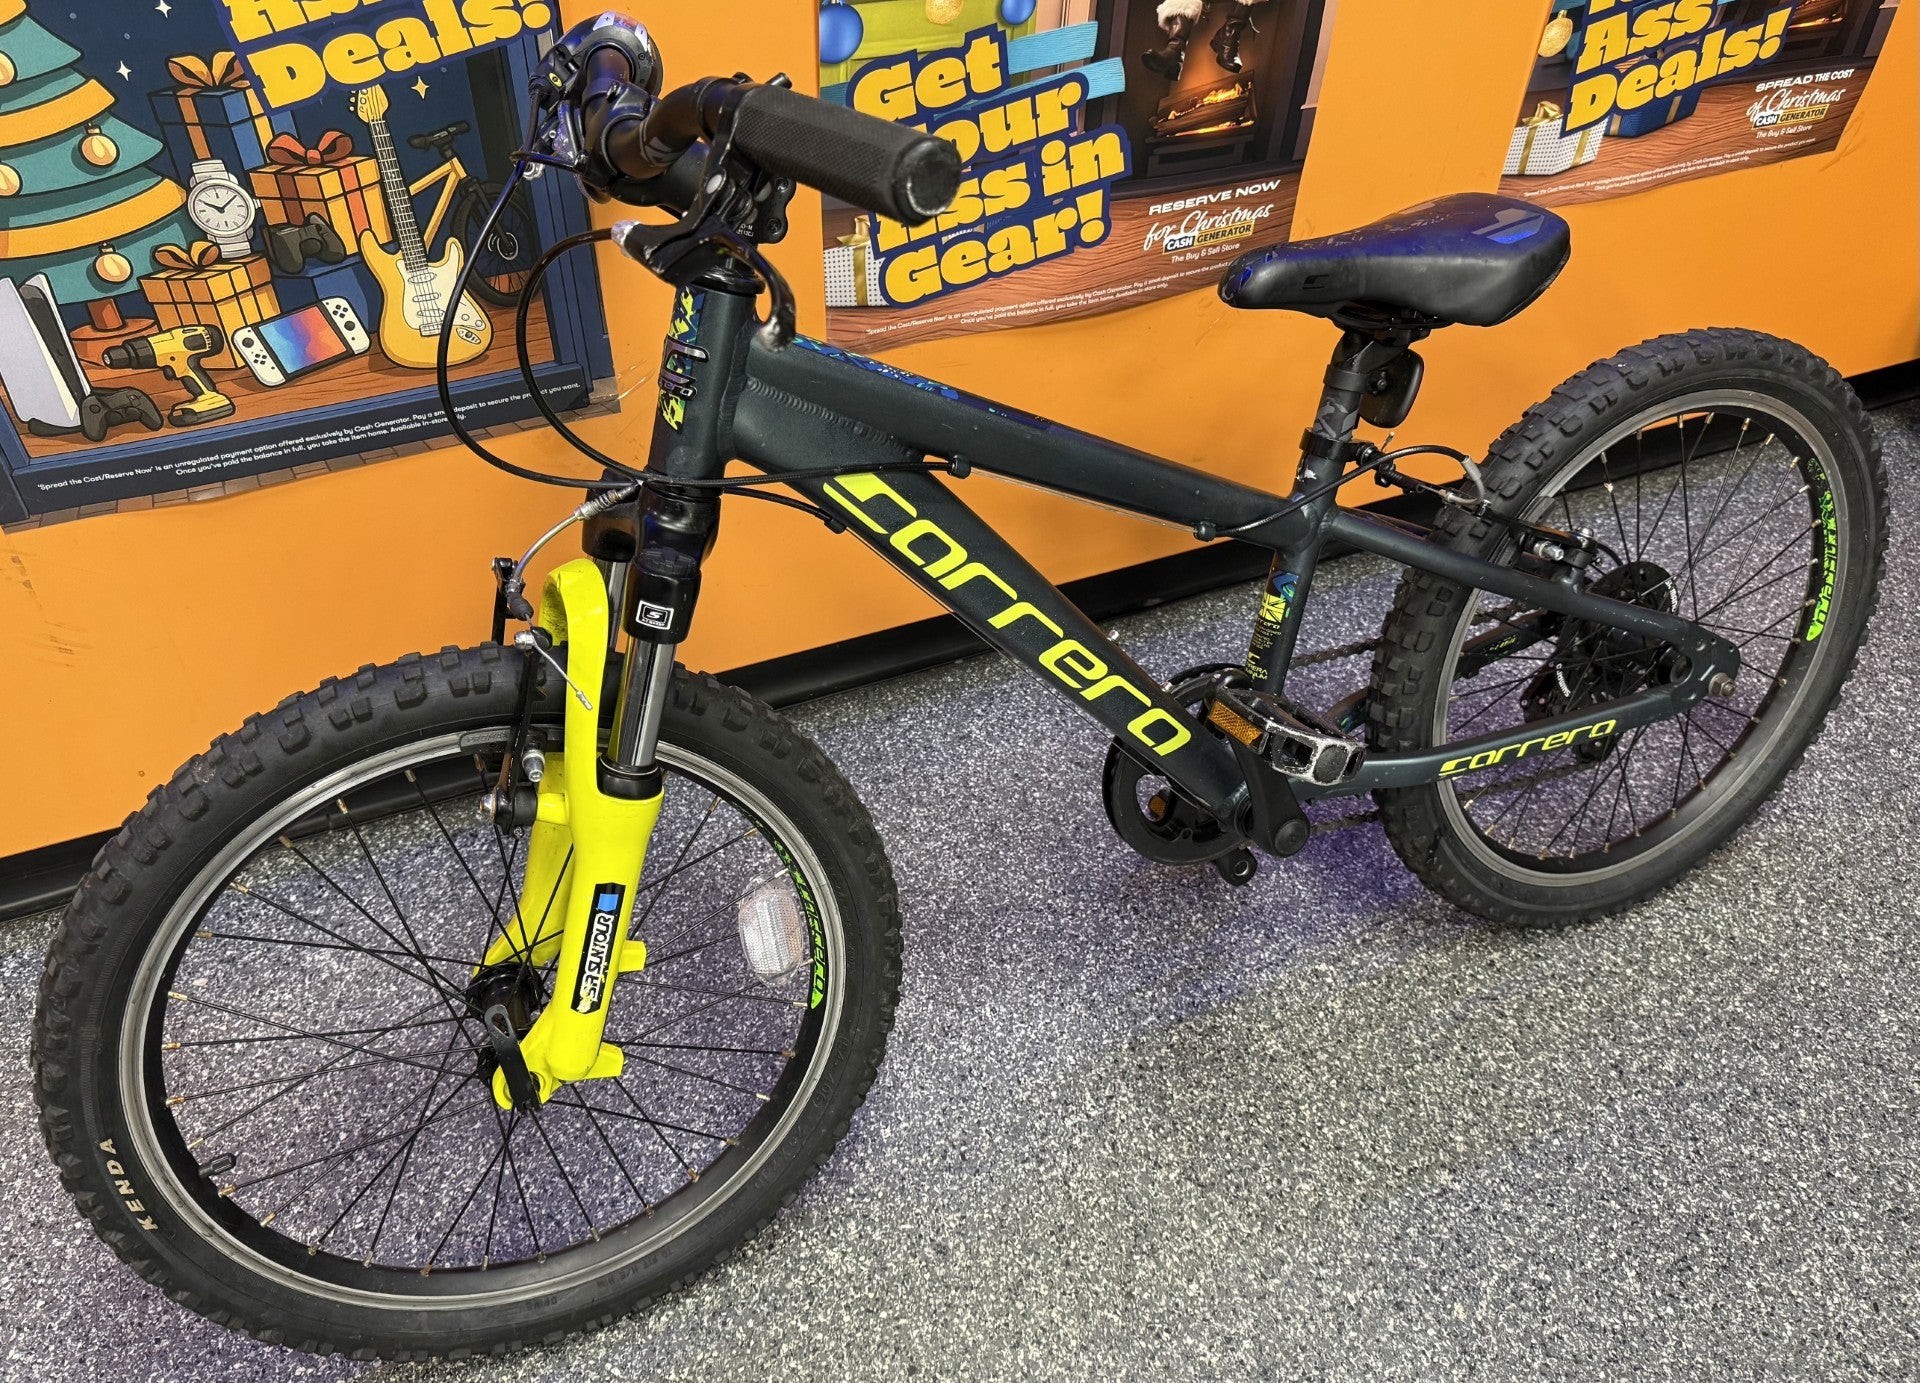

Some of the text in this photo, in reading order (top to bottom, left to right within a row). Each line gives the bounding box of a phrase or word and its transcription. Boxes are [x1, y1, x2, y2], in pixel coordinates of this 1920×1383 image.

[1576, 0, 1713, 74] Ass
[853, 35, 1002, 122] Get
[1565, 7, 1792, 131] Deals!
[1755, 69, 1855, 92] SPREAD THE COST
[1766, 88, 1846, 112] Christmas
[912, 81, 1082, 163] our
[1756, 108, 1826, 126] CASH GENERATOR
[1041, 132, 1125, 198] in
[1143, 204, 1275, 251] for Christmas
[1149, 180, 1281, 216] RESERVE NOW
[885, 189, 1105, 303] Gear!
[1166, 224, 1252, 251] CASH GENERATOR
[1171, 255, 1185, 264] The
[1185, 252, 1200, 262] Buy
[1207, 246, 1221, 256] Sell
[1221, 243, 1240, 253] Store
[660, 380, 693, 397] rera
[68, 477, 82, 486] the
[82, 469, 133, 483] Cost/Reserve
[174, 453, 219, 470] unregulated
[220, 446, 252, 460] payment
[253, 442, 277, 454] option
[278, 436, 304, 447] offered
[304, 429, 343, 444] exclusively
[343, 426, 353, 436] by
[353, 422, 373, 432] Cash
[412, 411, 426, 421] Pay
[453, 401, 478, 414] deposit
[478, 399, 487, 407] to
[487, 396, 509, 405] secure
[510, 393, 521, 401] the
[522, 387, 548, 400] prct
[548, 386, 561, 395] you
[175, 465, 196, 475] Once
[222, 457, 239, 468] paid
[240, 454, 252, 463] the
[253, 448, 282, 460] balance
[283, 446, 290, 454] in
[306, 441, 320, 451] you
[321, 437, 337, 446] take
[338, 434, 350, 443] the
[350, 431, 366, 440] item
[390, 420, 421, 432] Available
[456, 411, 466, 421] ly.
[585, 913, 614, 975] SUNTOUR
[99, 1138, 159, 1230] KENDA
